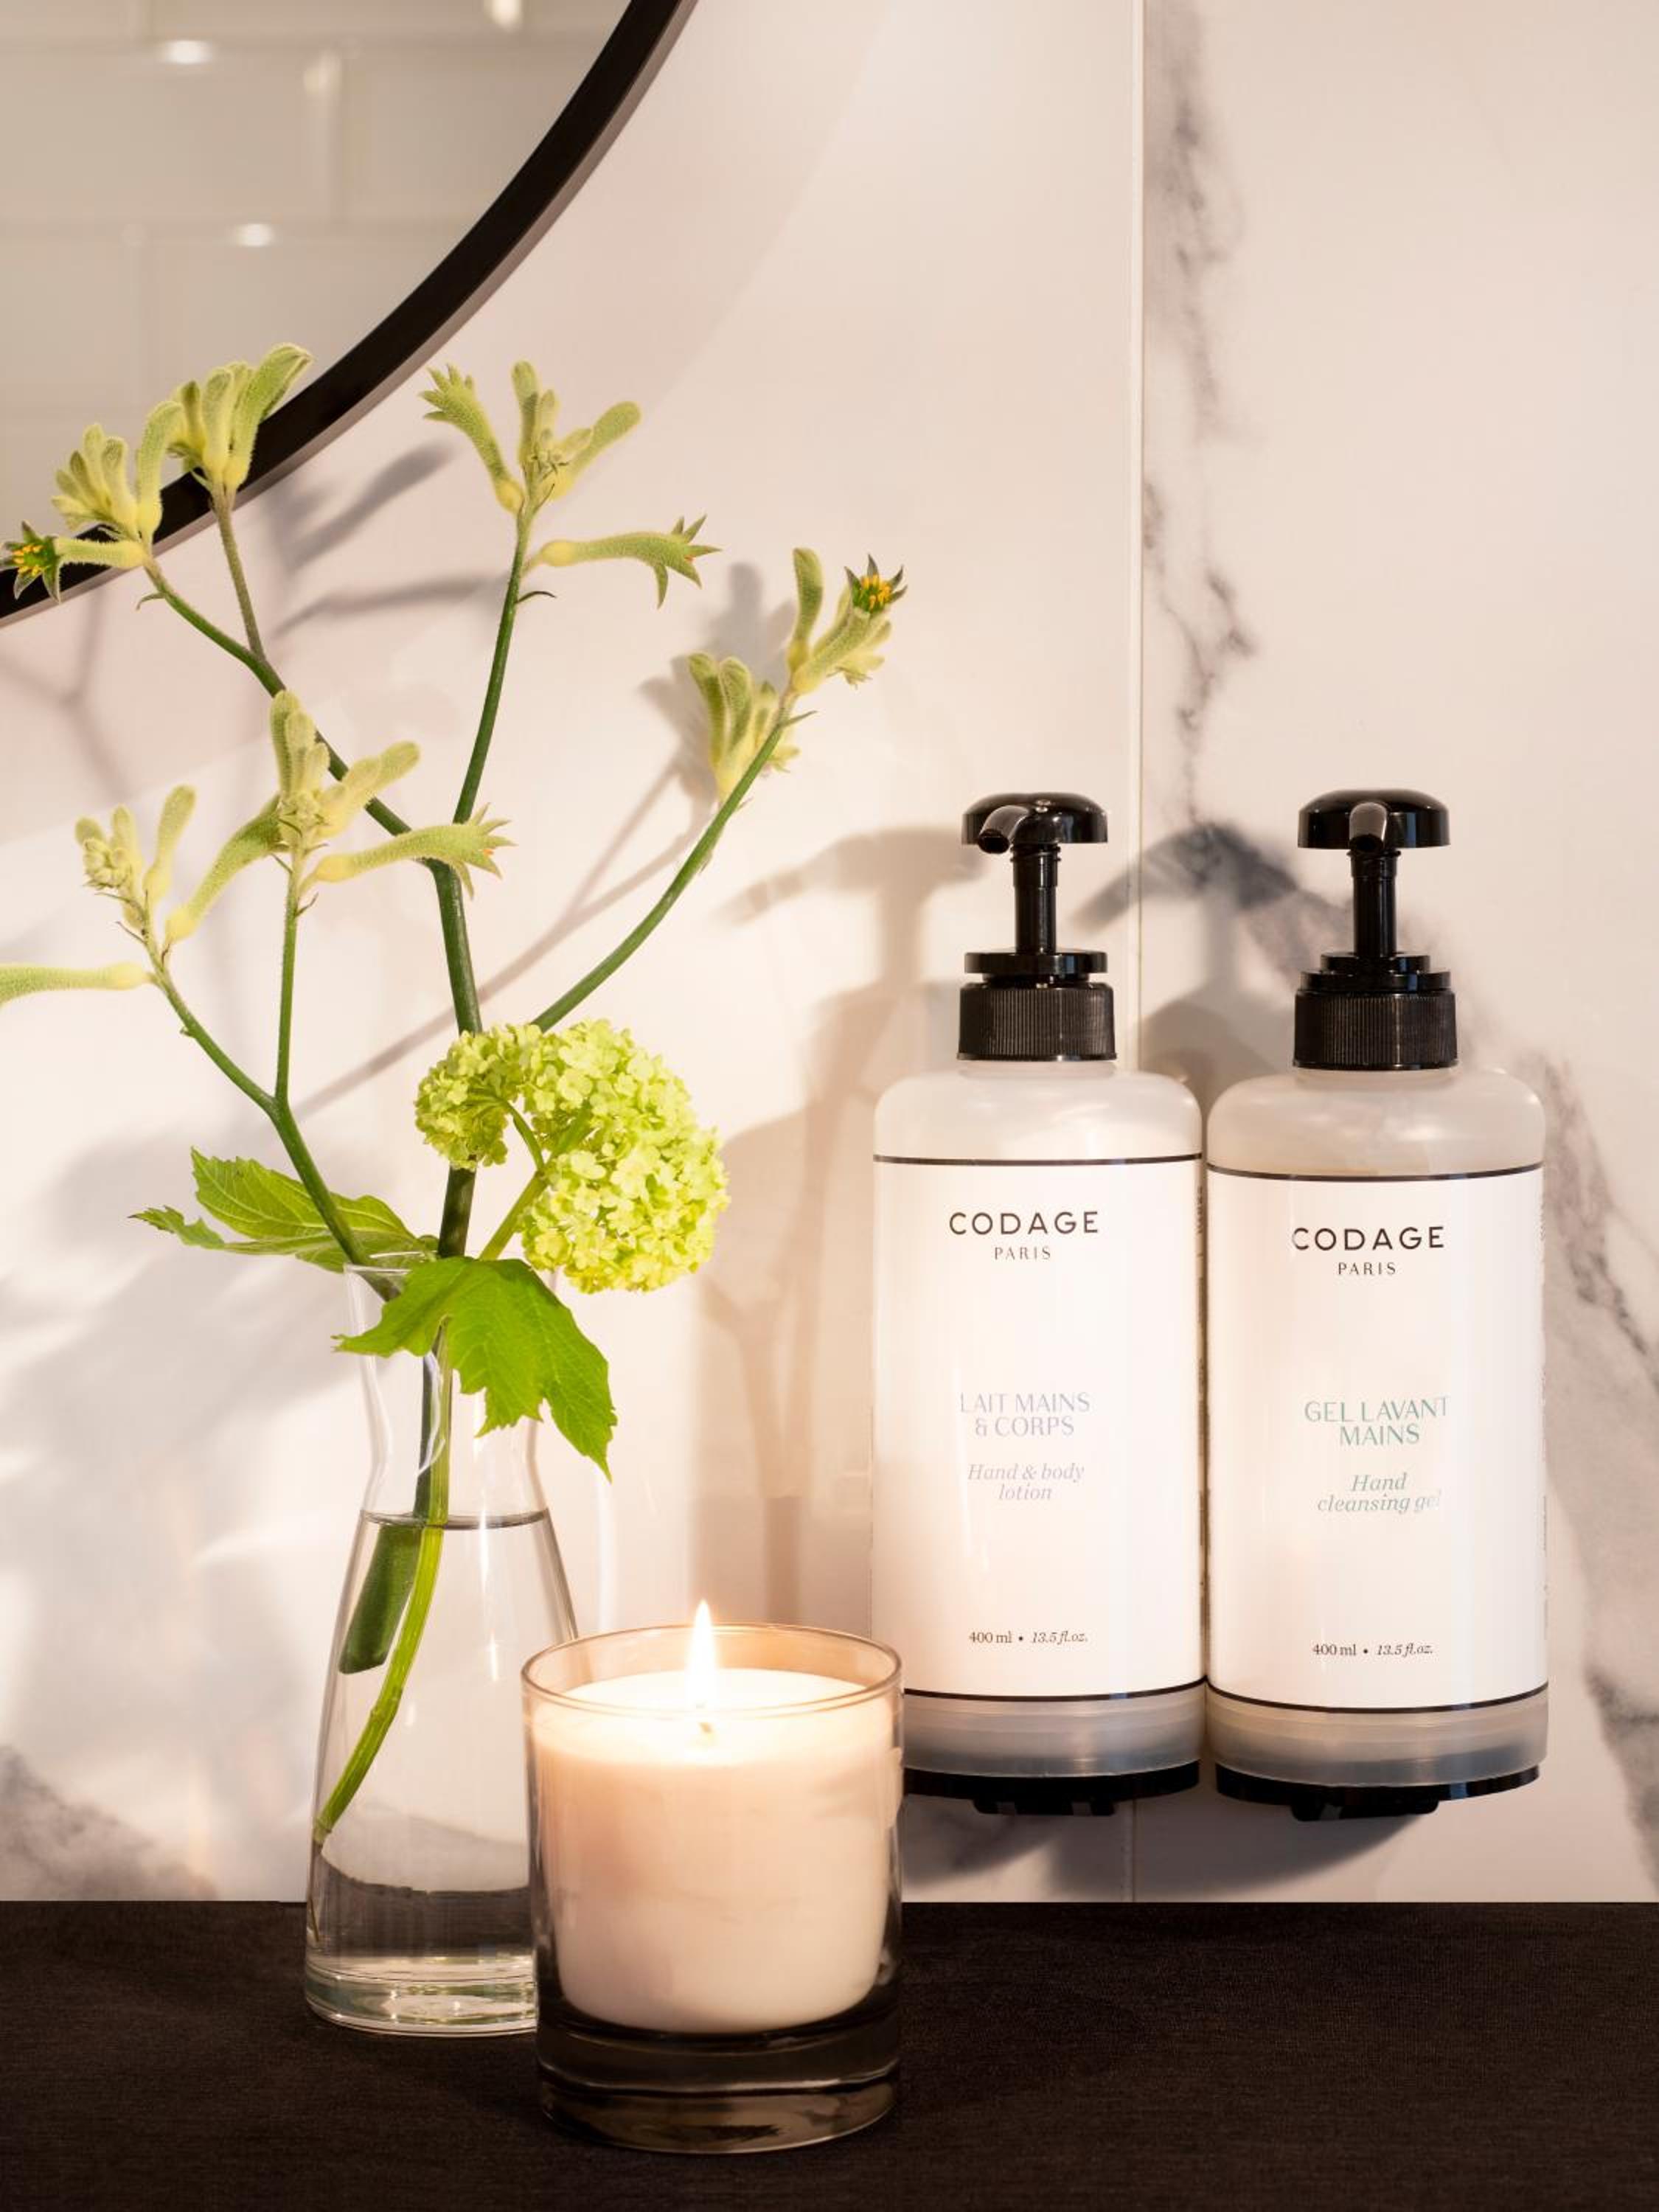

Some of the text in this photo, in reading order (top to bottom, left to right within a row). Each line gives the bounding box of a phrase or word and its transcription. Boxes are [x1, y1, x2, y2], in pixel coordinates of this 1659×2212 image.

[949, 1211, 1099, 1235] CODAGE
[1291, 1226, 1444, 1251] CODAGE
[994, 1246, 1051, 1260] PARIS
[1338, 1262, 1397, 1276] PARIS
[960, 1391, 1091, 1413] LAIT MAINS
[1304, 1396, 1449, 1423] GEL LAVANT
[974, 1416, 1075, 1437] & CORPS
[1339, 1423, 1421, 1446] MAINS
[967, 1462, 1085, 1483] Hand & body
[1350, 1472, 1408, 1492] Hand
[998, 1483, 1053, 1501] lotion
[1318, 1493, 1410, 1515] cleansing
[969, 1631, 993, 1644] 400
[995, 1630, 1012, 1644] ml
[1312, 1644, 1337, 1655] 400
[1340, 1644, 1357, 1656] ml
